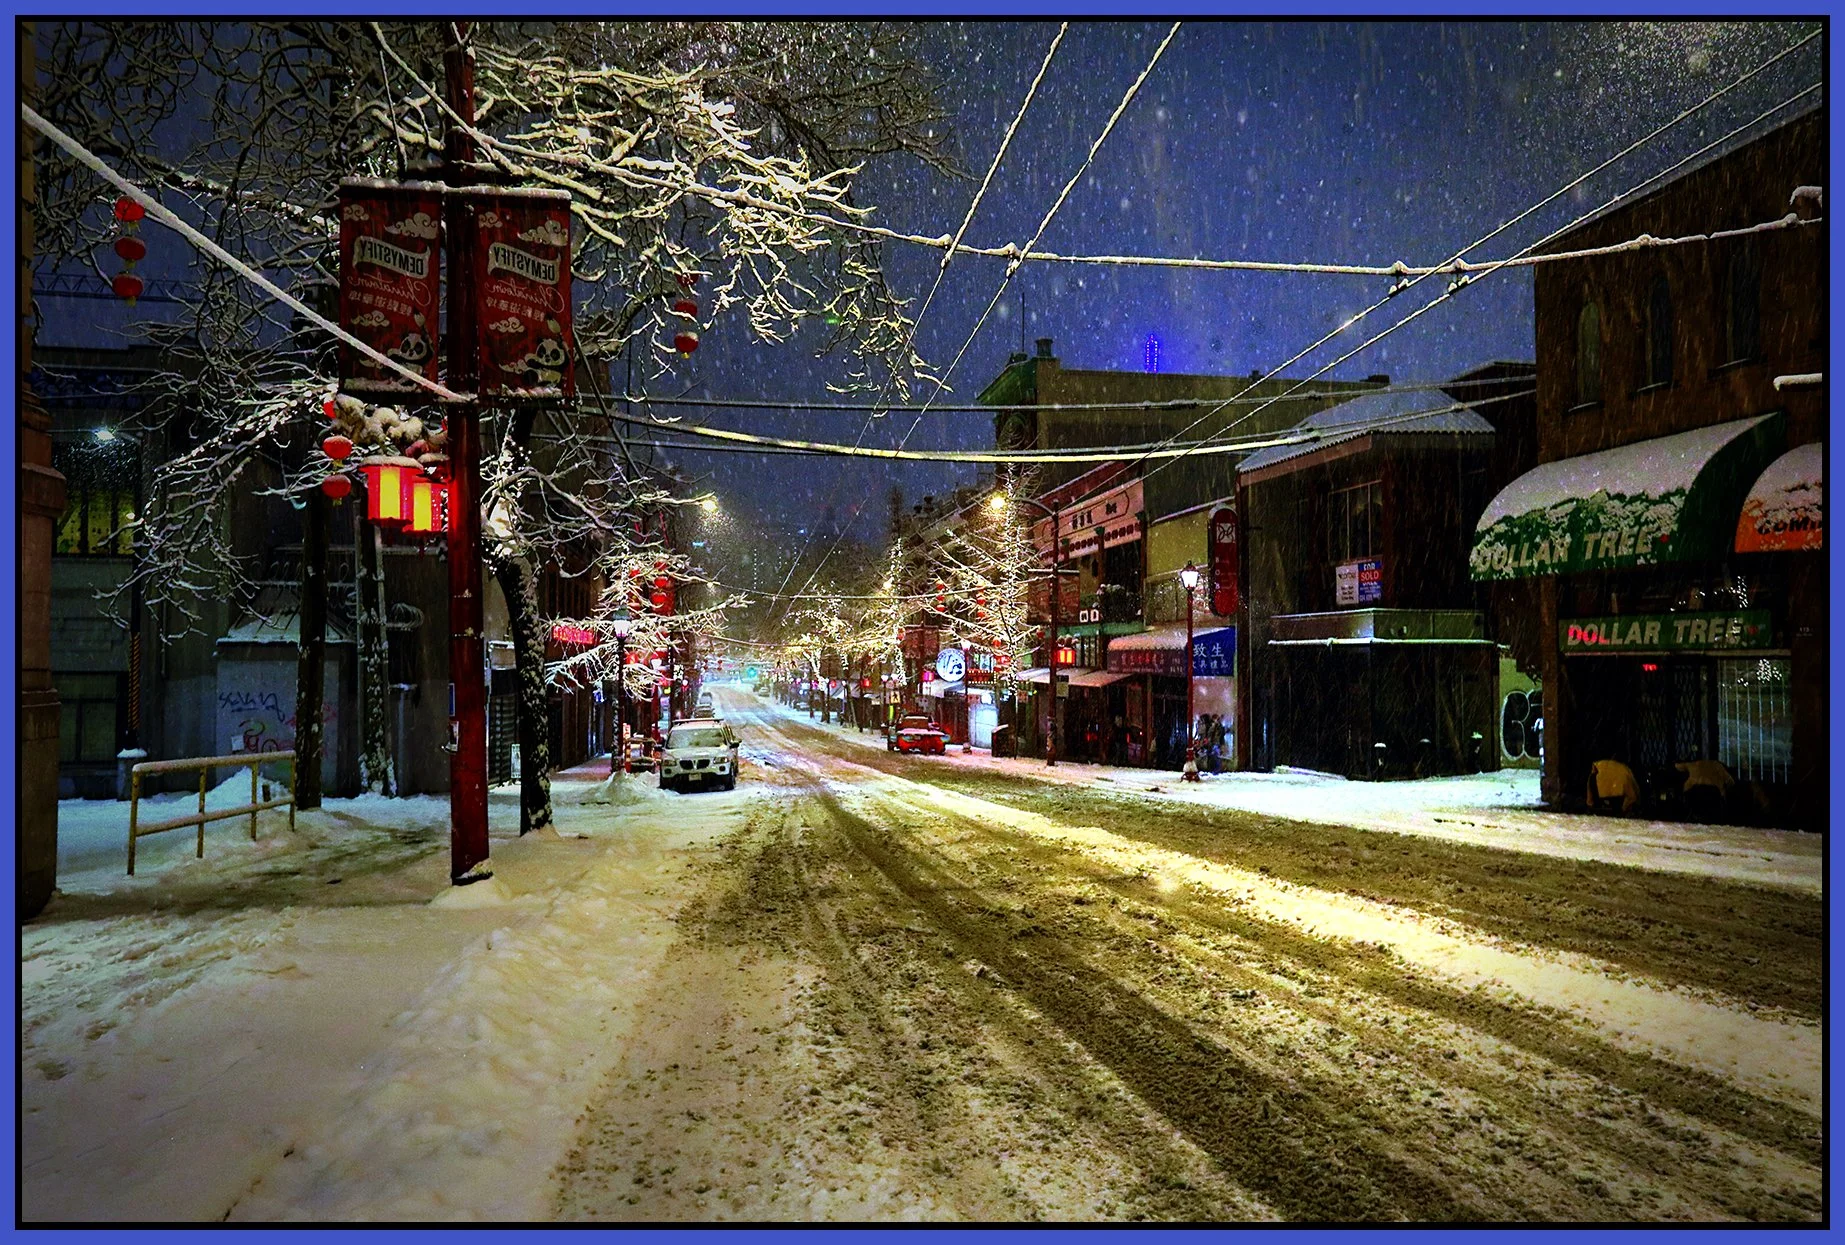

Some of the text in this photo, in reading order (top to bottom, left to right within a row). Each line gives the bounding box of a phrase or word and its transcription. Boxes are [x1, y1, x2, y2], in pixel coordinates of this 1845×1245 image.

[1471, 526, 1655, 573] DOLLAR TREE
[1361, 570, 1379, 582] SOLD
[1567, 618, 1743, 646] DOLLAR TREE
